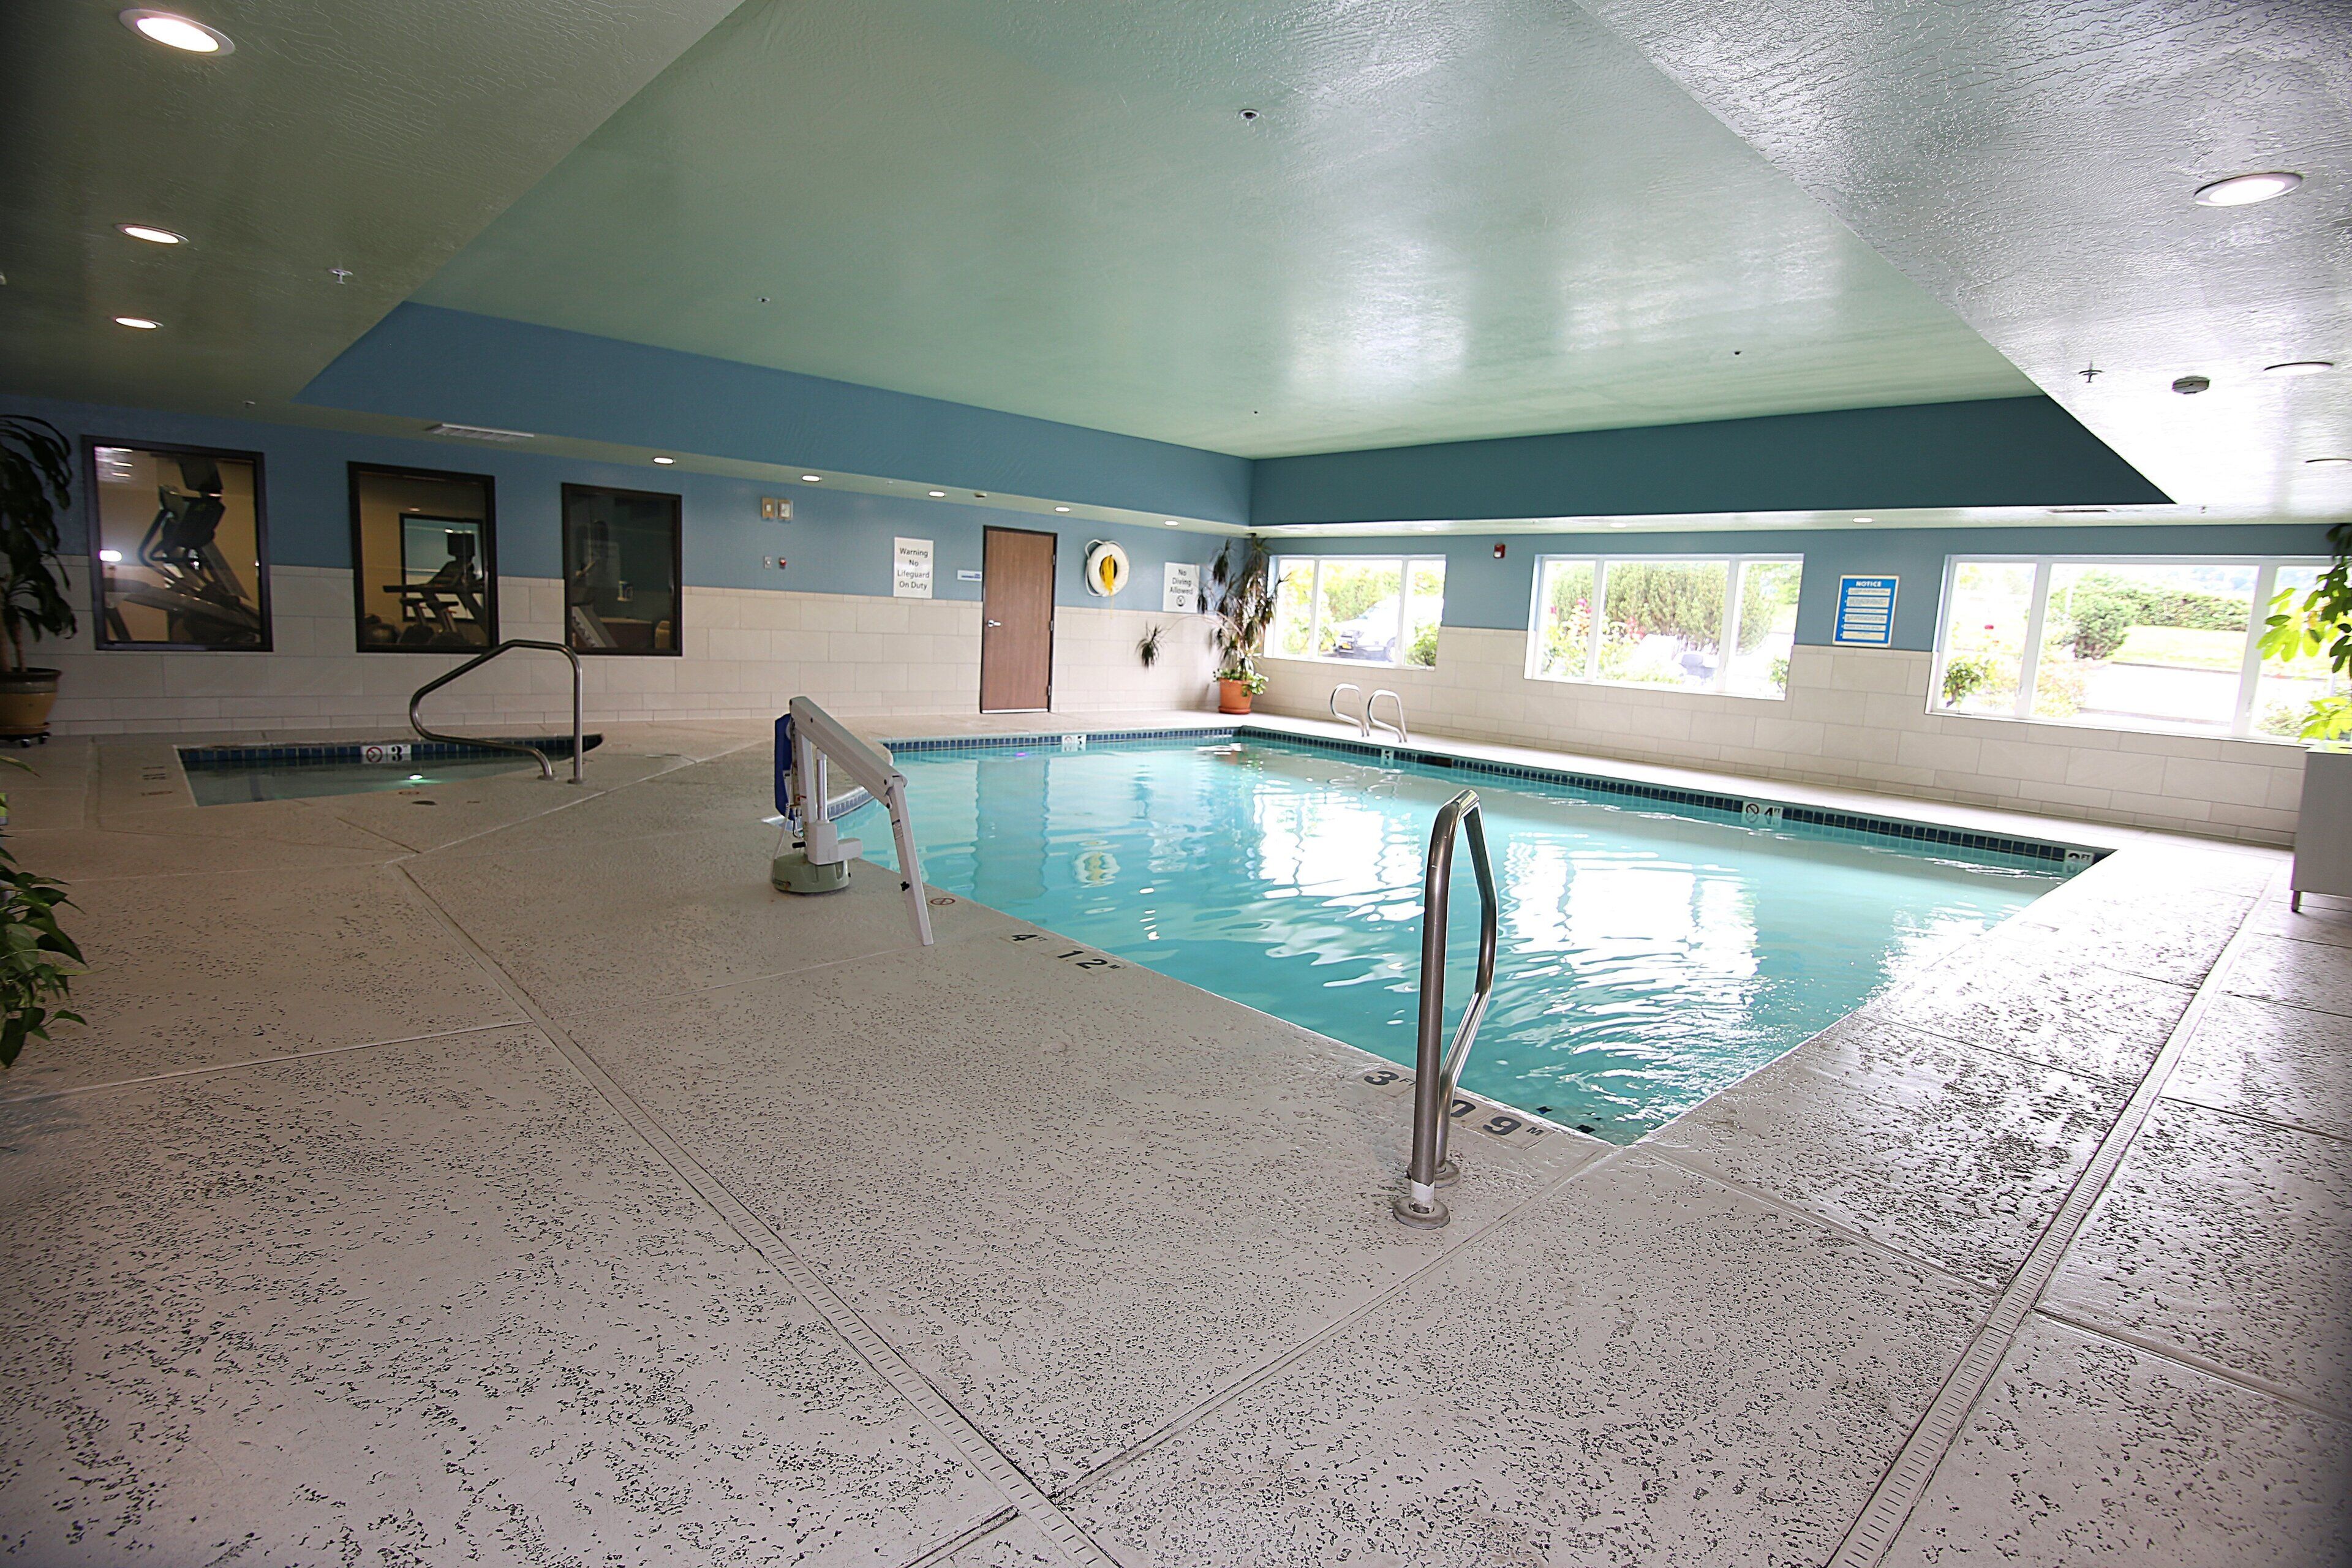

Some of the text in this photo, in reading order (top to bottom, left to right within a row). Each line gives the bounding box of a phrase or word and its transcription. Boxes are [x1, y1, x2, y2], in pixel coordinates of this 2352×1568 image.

[900, 548, 929, 558] Warning
[897, 570, 930, 579] Lifeguard
[911, 582, 928, 590] Duty
[1172, 578, 1191, 587] Diving
[1364, 1071, 1399, 1085] 3
[1526, 1127, 1544, 1136] M
